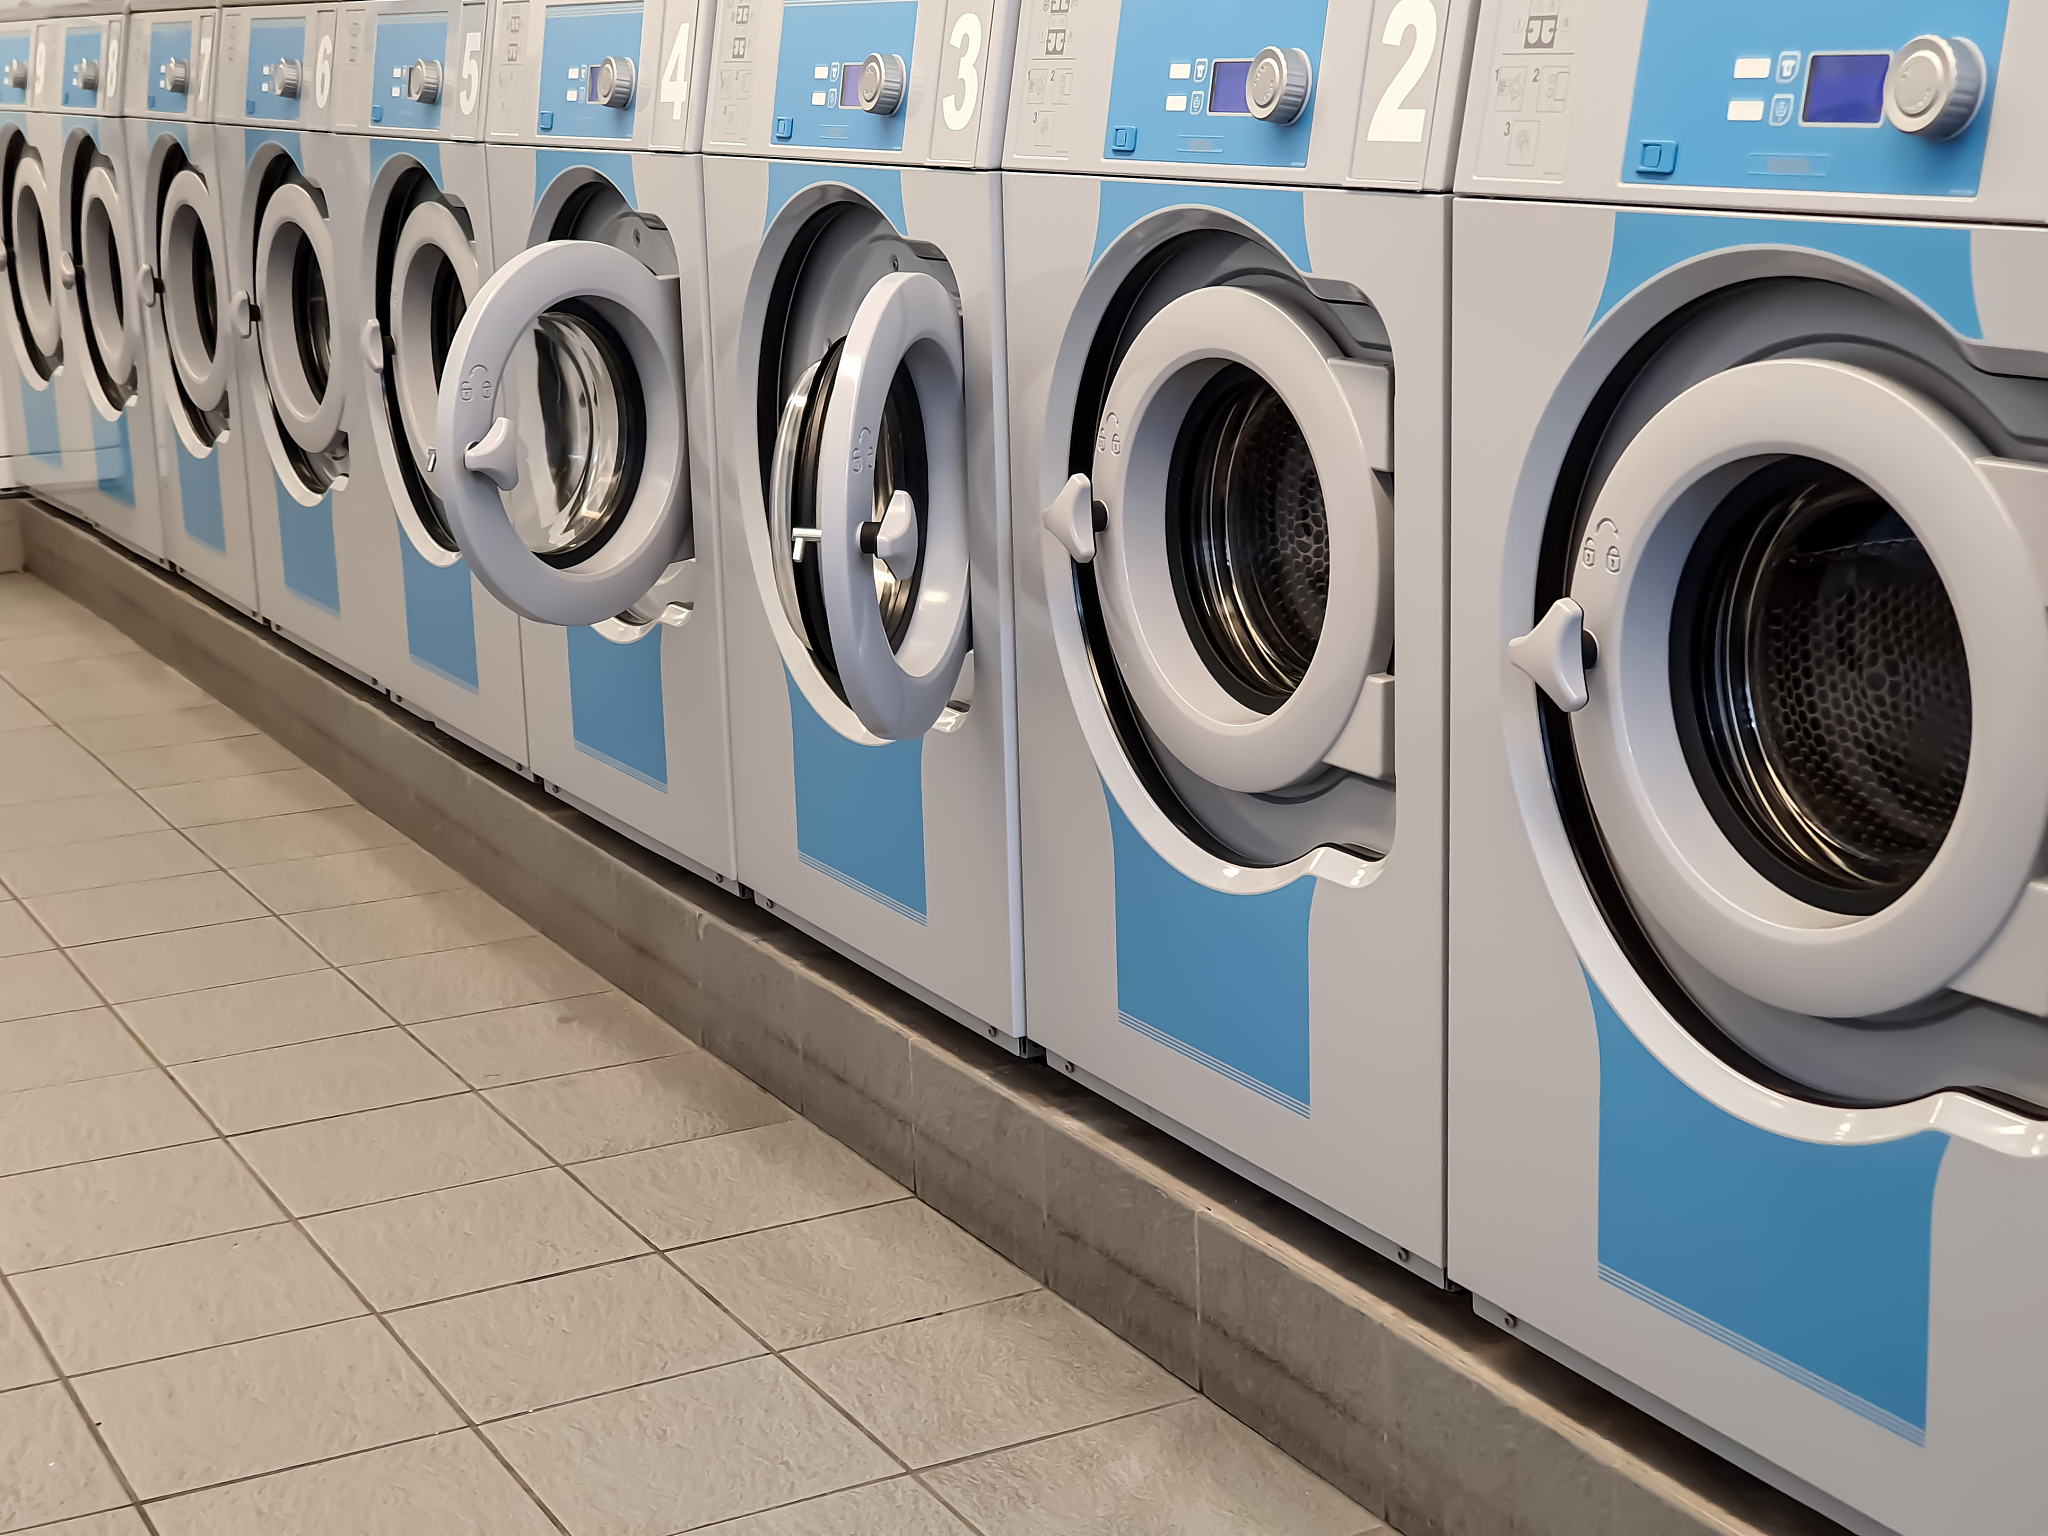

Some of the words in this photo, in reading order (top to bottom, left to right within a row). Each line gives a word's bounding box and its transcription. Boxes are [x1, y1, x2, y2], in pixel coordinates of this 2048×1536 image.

[35, 41, 46, 94] 9
[107, 38, 119, 98] 8
[199, 38, 212, 101] 7
[315, 35, 332, 109] 6
[459, 32, 481, 116] 5
[660, 22, 690, 120] 4
[943, 12, 982, 131] 3
[1366, 0, 1437, 143] 2
[1532, 68, 1540, 82] 2
[1503, 121, 1511, 137] 3
